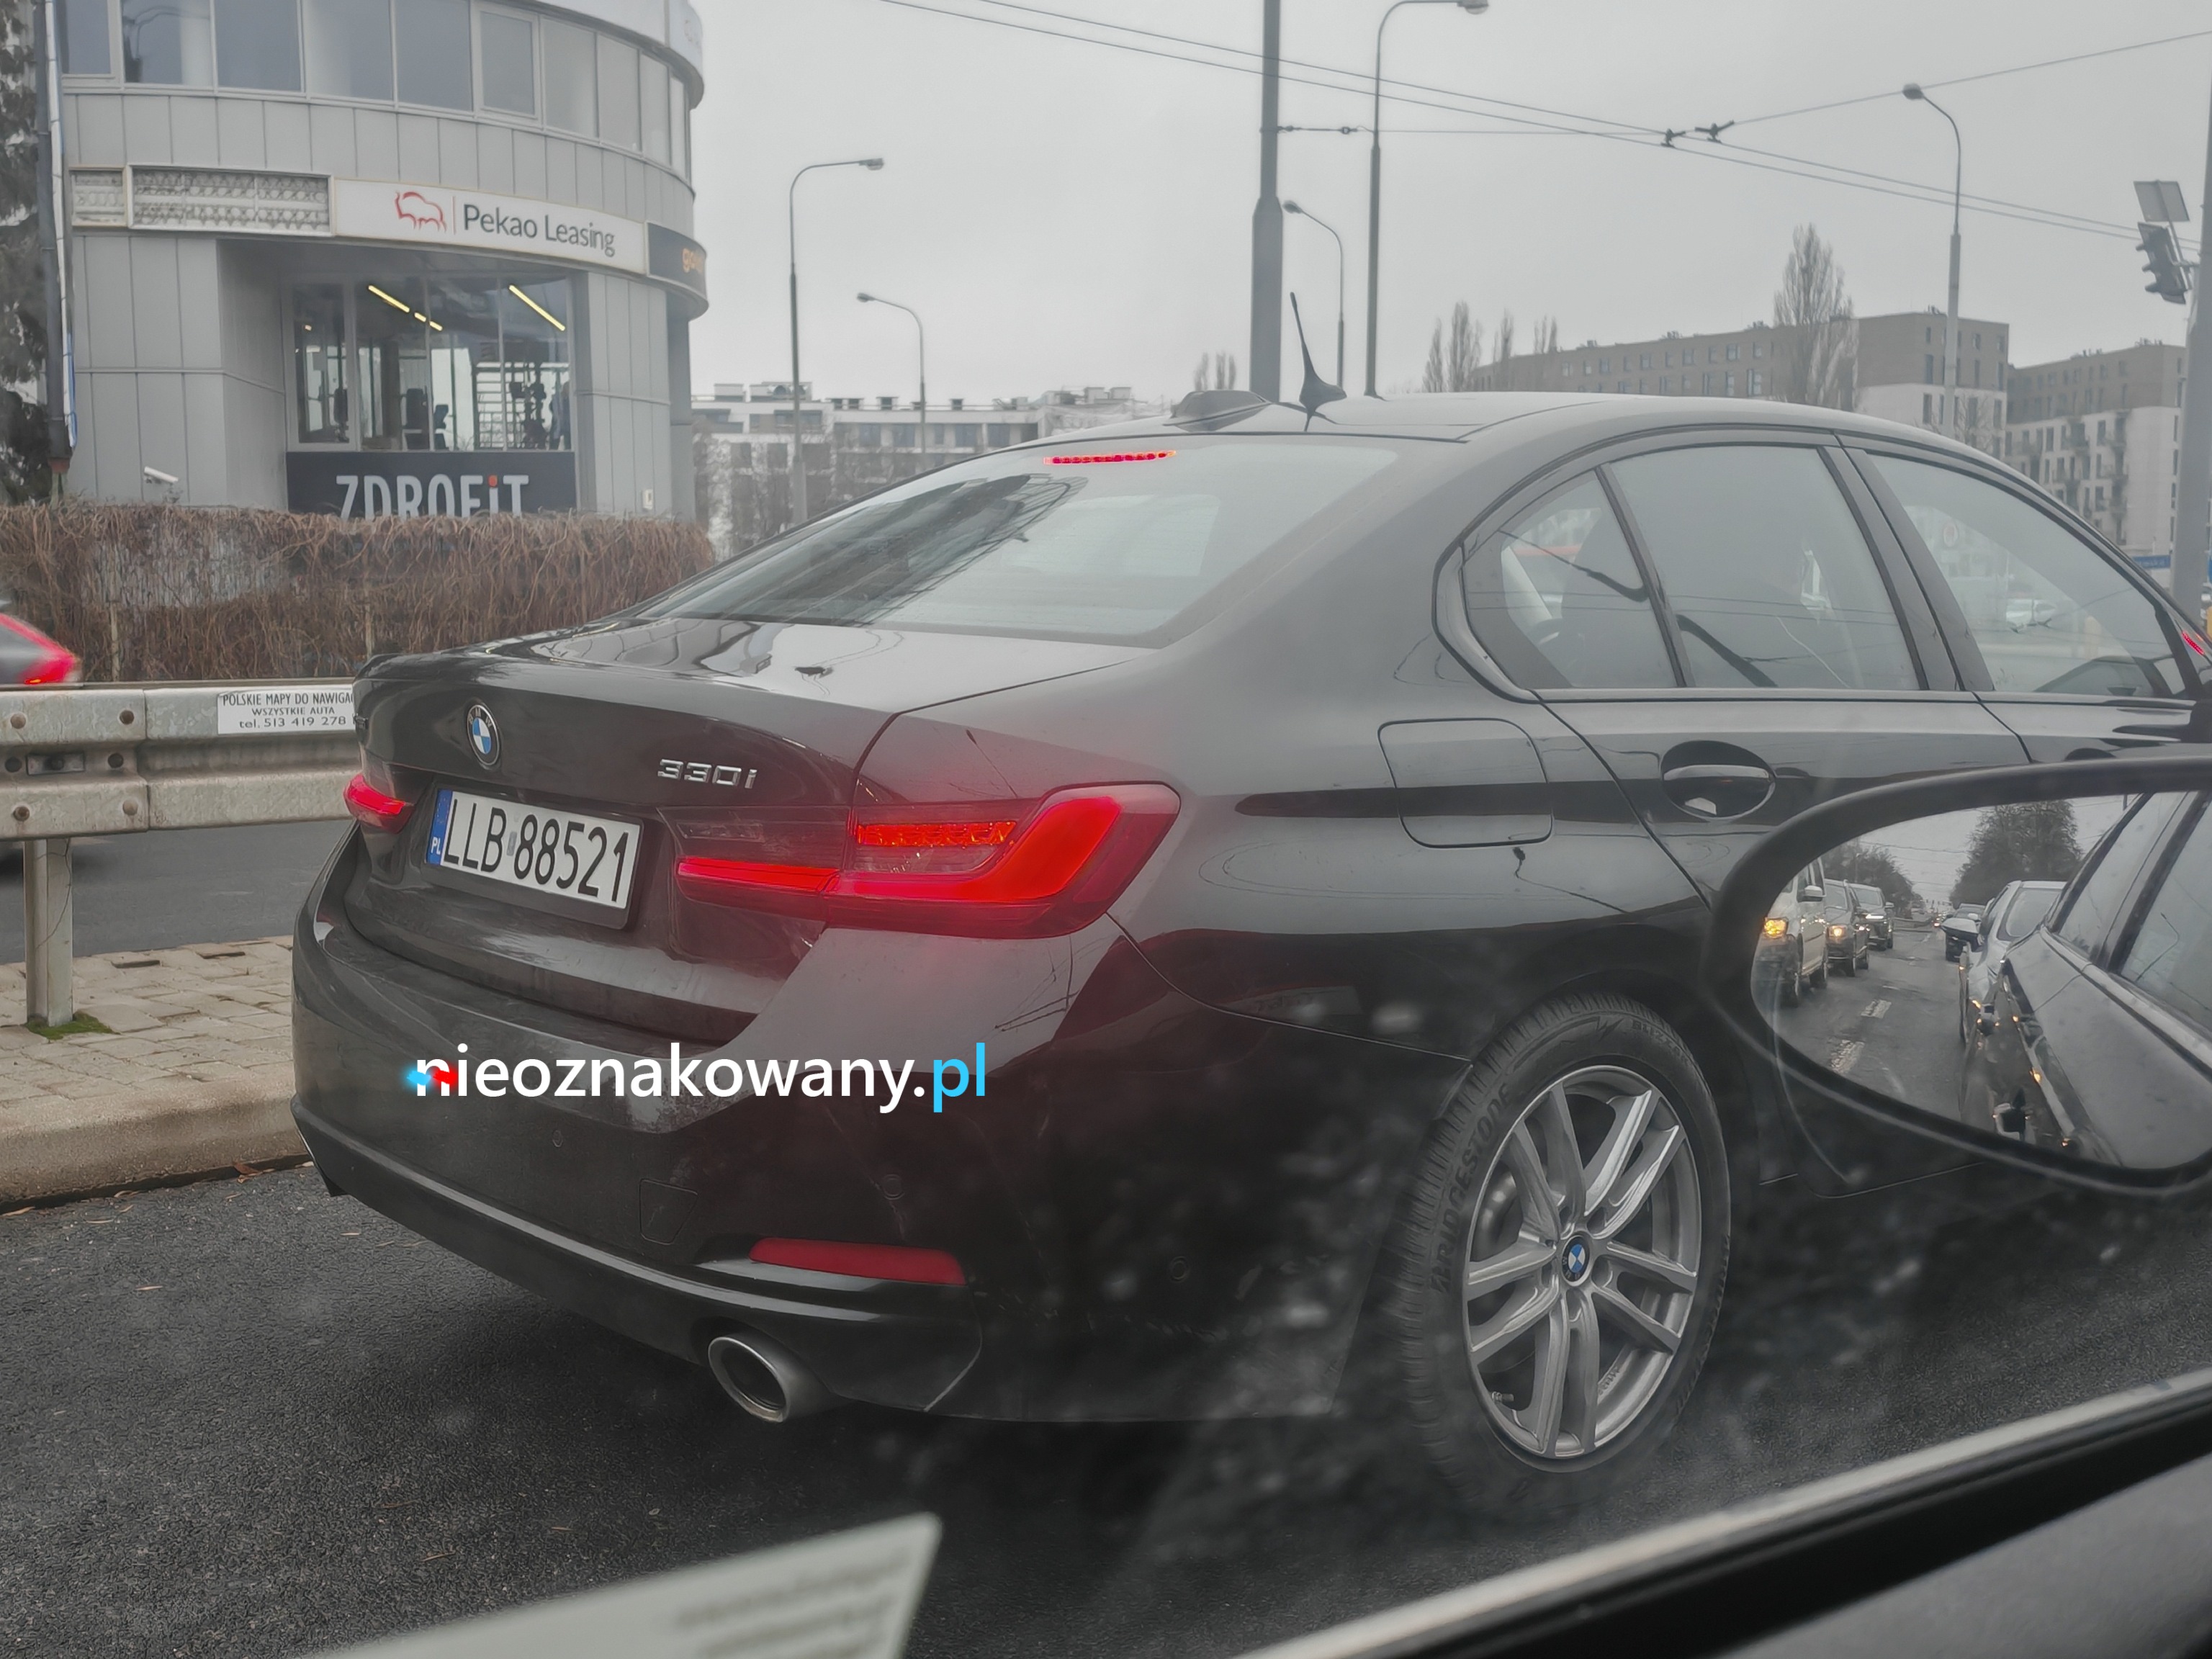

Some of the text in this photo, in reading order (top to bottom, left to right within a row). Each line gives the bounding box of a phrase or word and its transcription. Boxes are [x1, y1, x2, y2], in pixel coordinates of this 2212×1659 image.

[463, 203, 616, 258] Pekao Leasing
[222, 693, 261, 706] POLSKIE
[266, 692, 291, 706] MAPY
[295, 692, 309, 705] DO
[251, 706, 335, 716] WSZYSTKIE AUTA
[239, 719, 260, 729] tel.
[264, 717, 285, 727] 513
[291, 716, 315, 727] 419
[321, 716, 346, 726] 278
[657, 758, 757, 789] 330i
[431, 836, 441, 855] PL
[444, 799, 629, 902] LLB 88521
